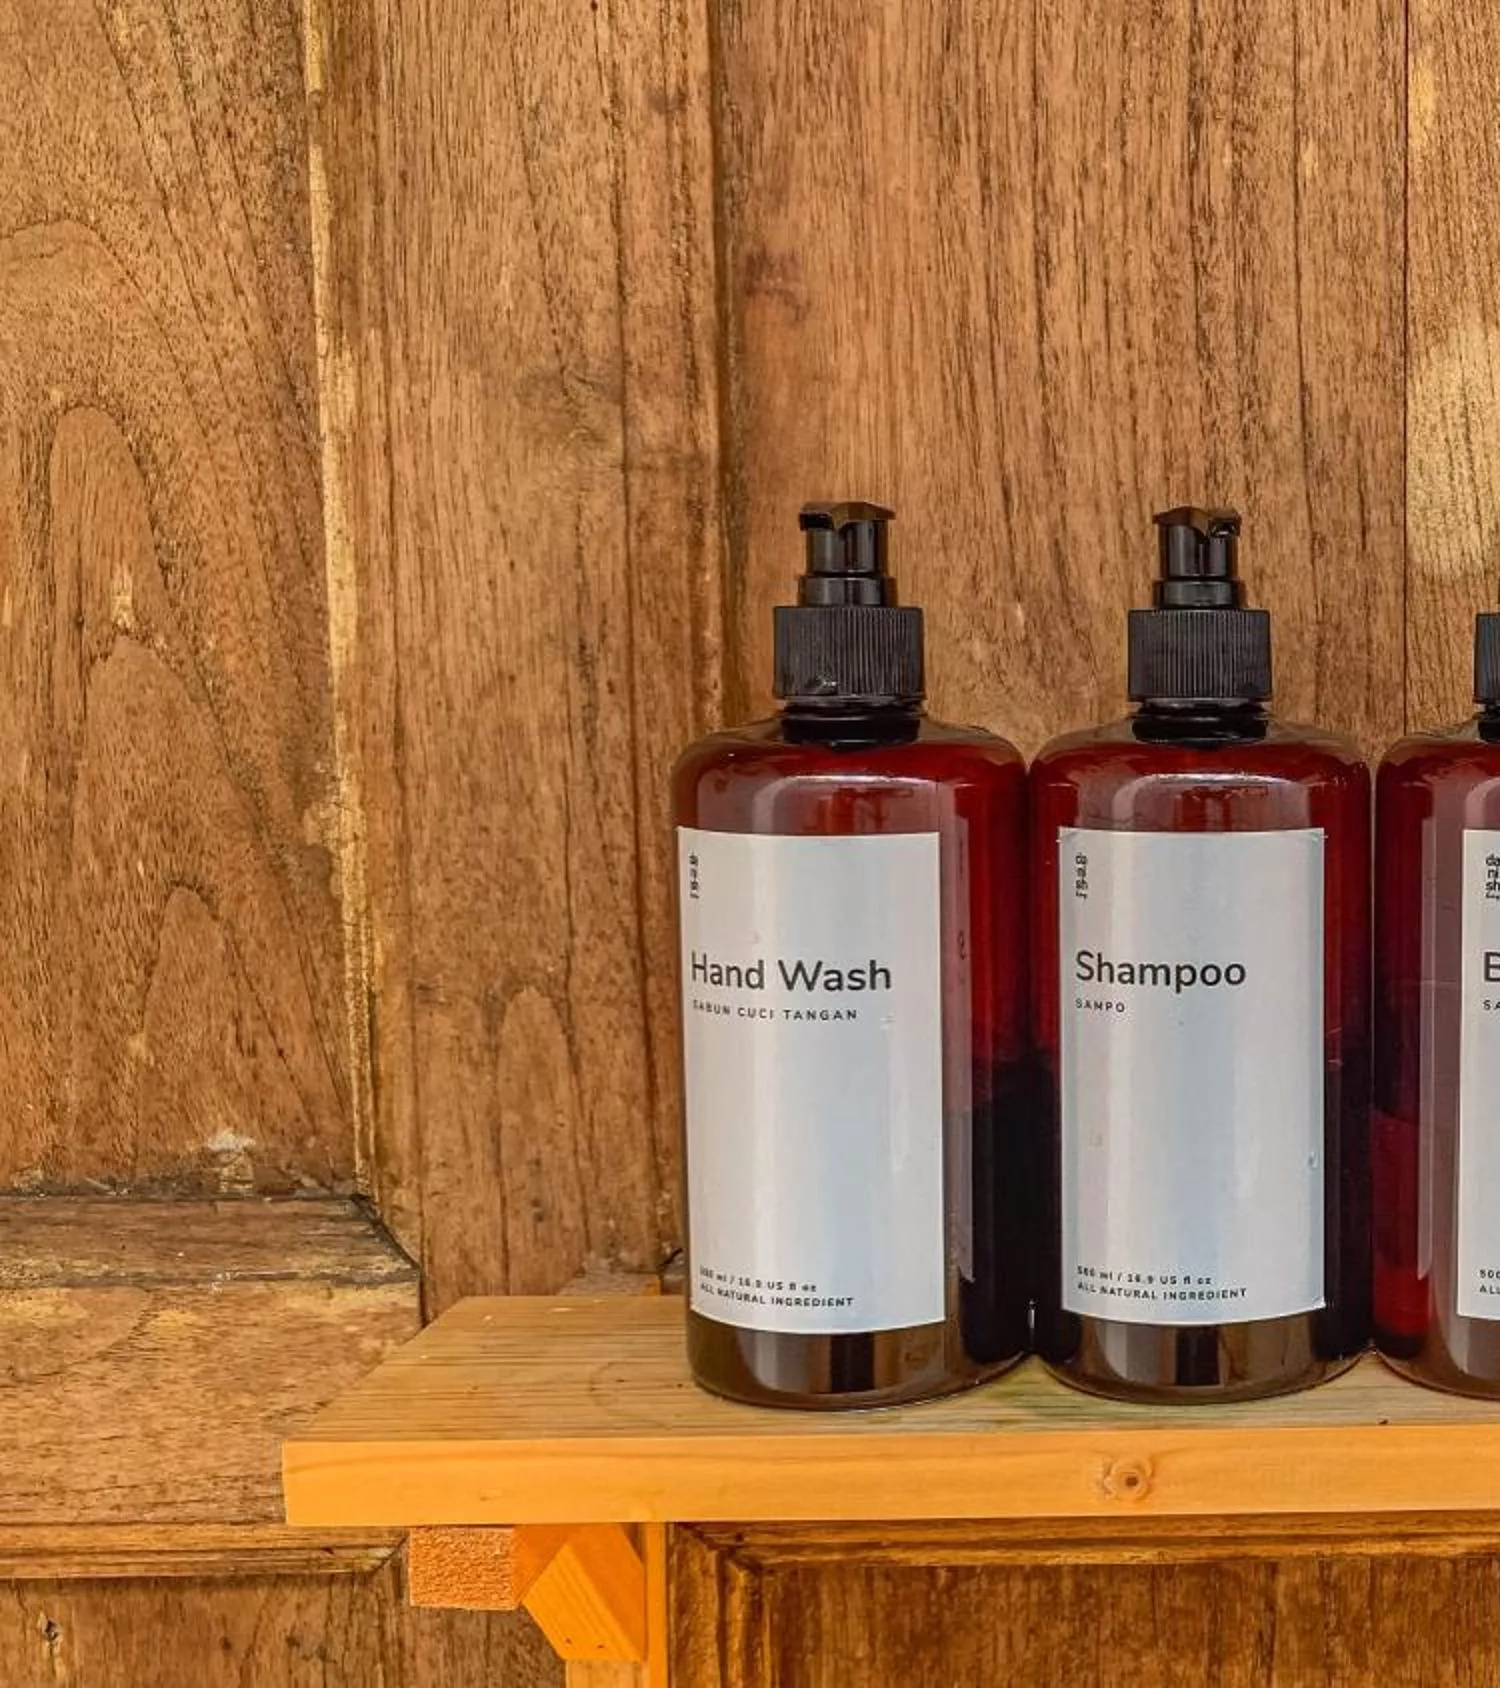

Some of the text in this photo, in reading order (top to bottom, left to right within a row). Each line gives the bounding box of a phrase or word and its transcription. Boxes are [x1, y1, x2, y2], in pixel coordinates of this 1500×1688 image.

[691, 951, 892, 992] Hand Wash
[1075, 950, 1246, 994] Shampoo
[692, 1000, 858, 1021] SABUN CUCI TANGAN
[1075, 999, 1125, 1013] SAMPO
[767, 1281, 783, 1291] US
[1100, 1271, 1113, 1281] ml
[1160, 1275, 1177, 1285] US
[700, 1282, 855, 1307] ALL NATURAL INGREDIENT
[1077, 1281, 1247, 1301] ALL NATURAL INGREDIENT
